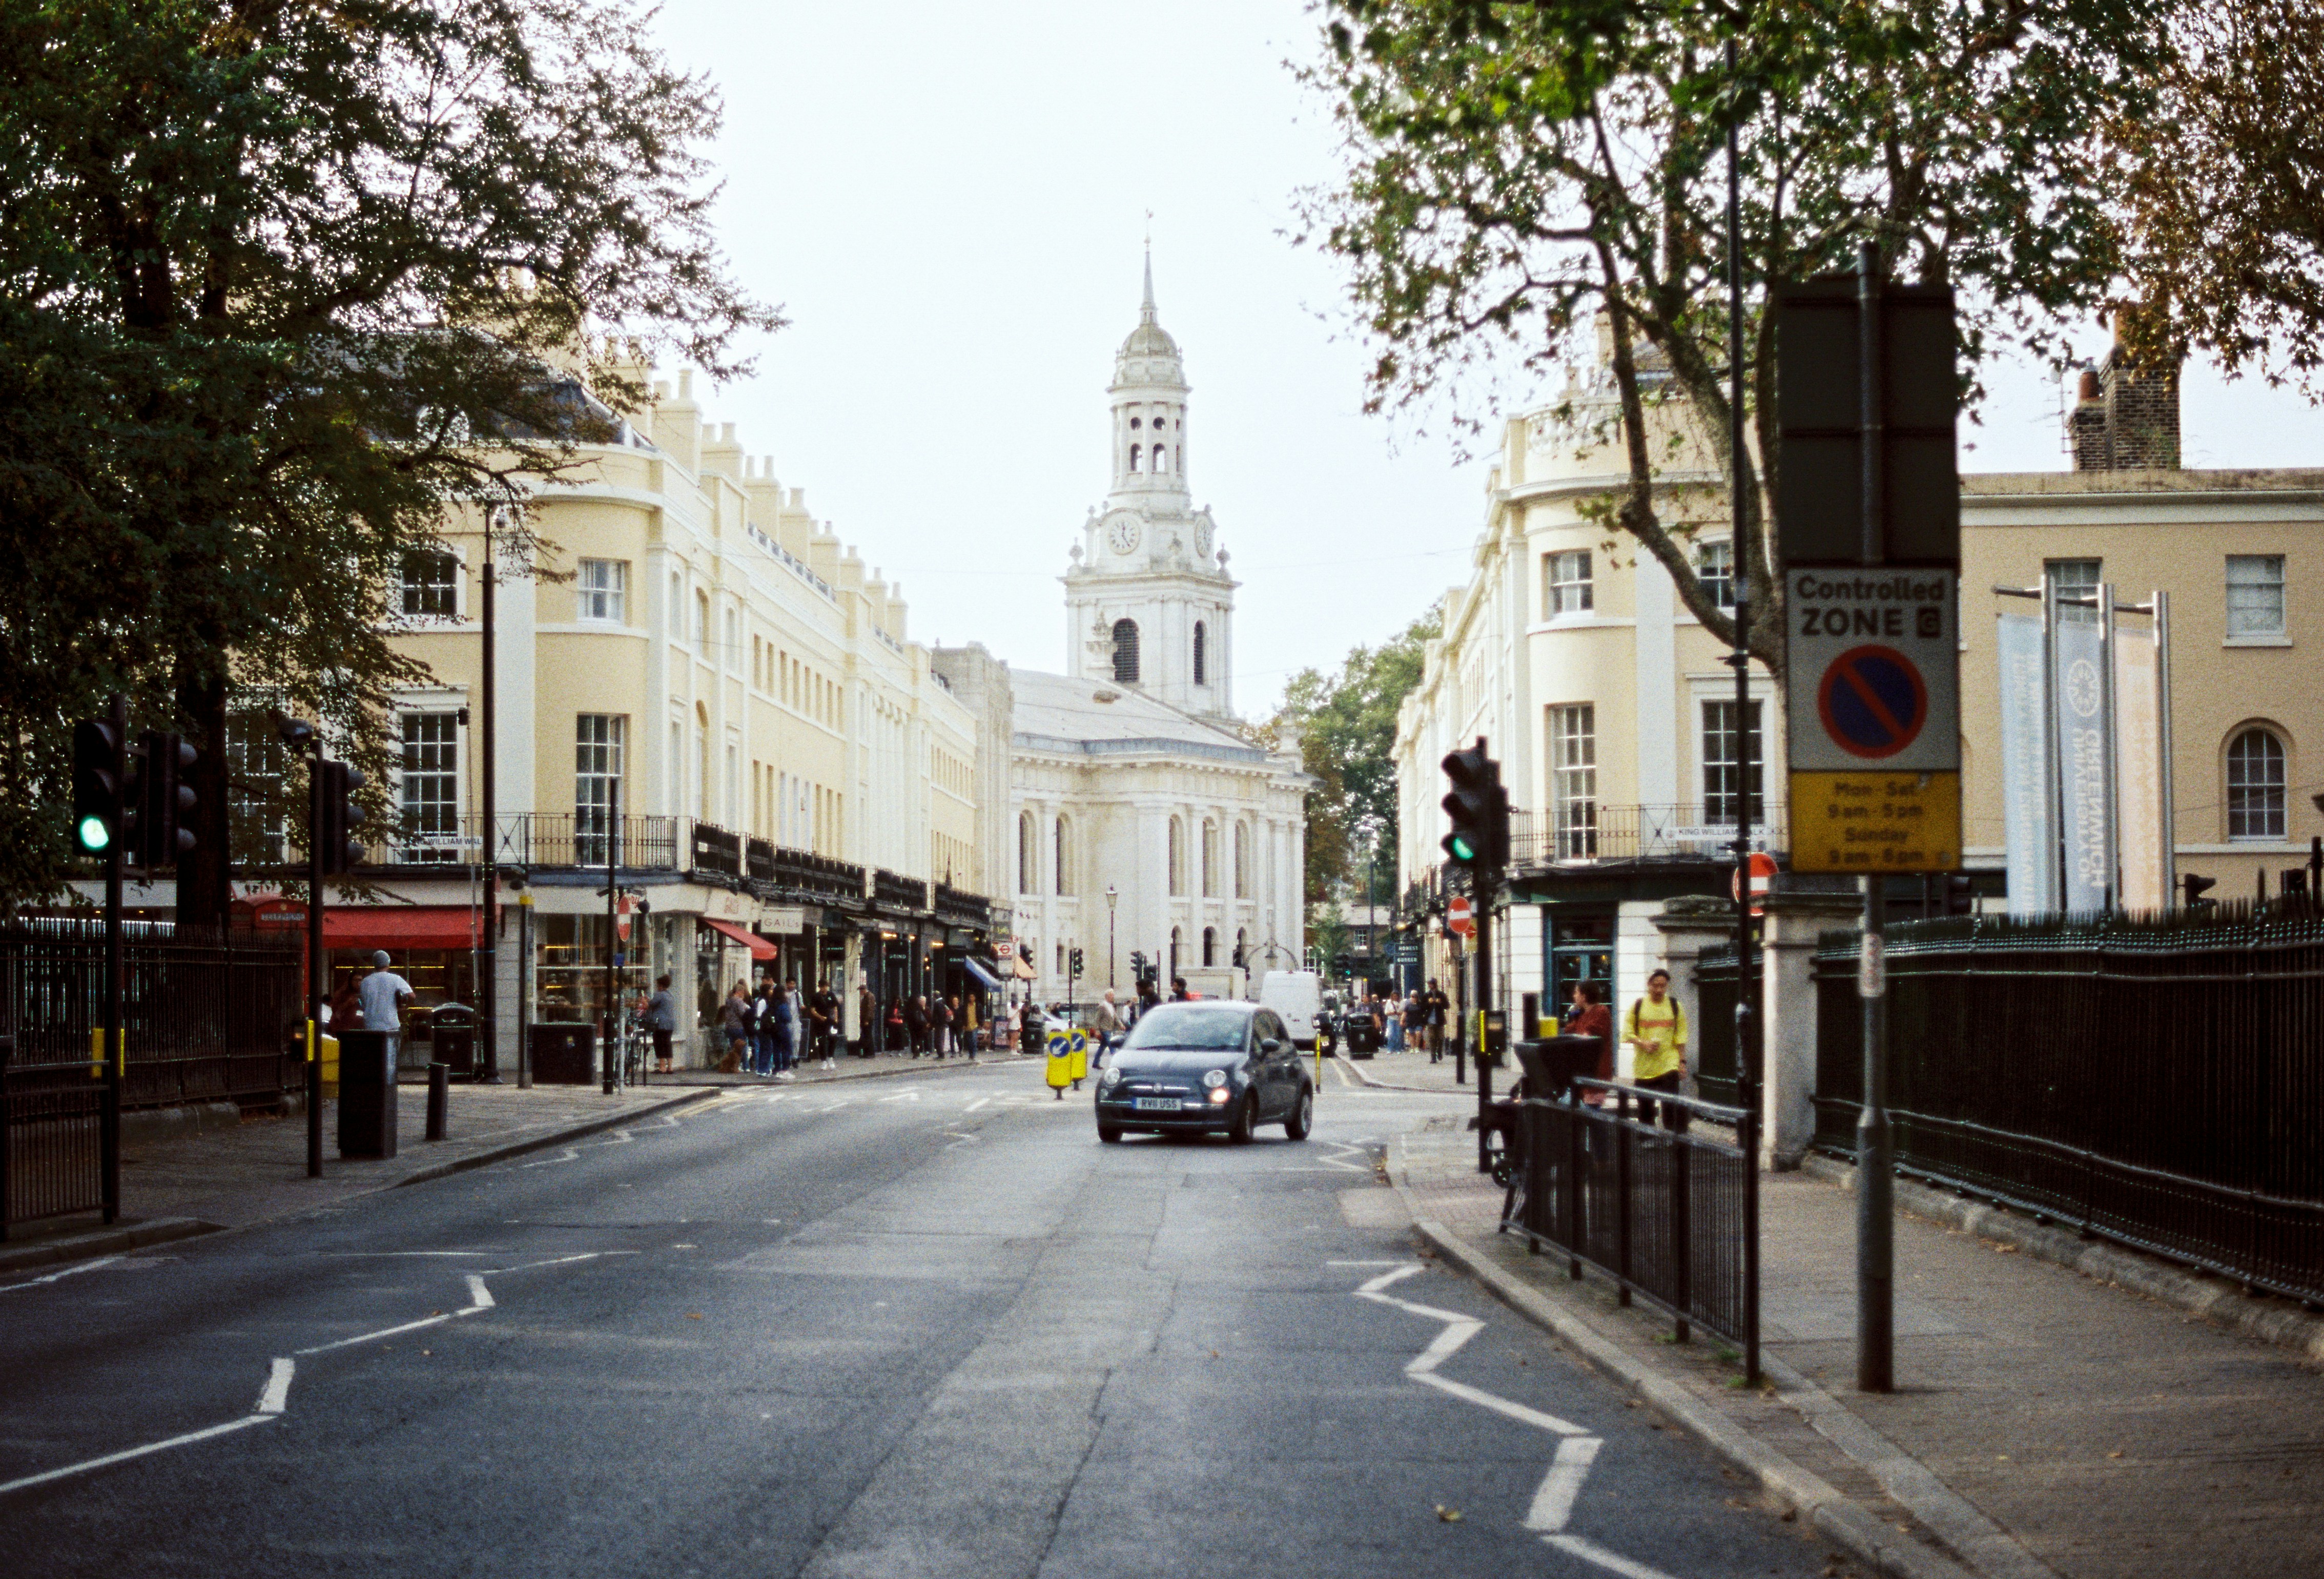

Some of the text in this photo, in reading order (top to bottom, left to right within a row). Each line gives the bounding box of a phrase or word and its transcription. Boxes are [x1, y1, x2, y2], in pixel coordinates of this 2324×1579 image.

[1796, 575, 1944, 599] Controlled
[1802, 608, 1939, 637] ZONE G
[1835, 782, 1871, 796] Mon
[1886, 781, 1916, 797] Sat
[1845, 827, 1907, 844] Sunday
